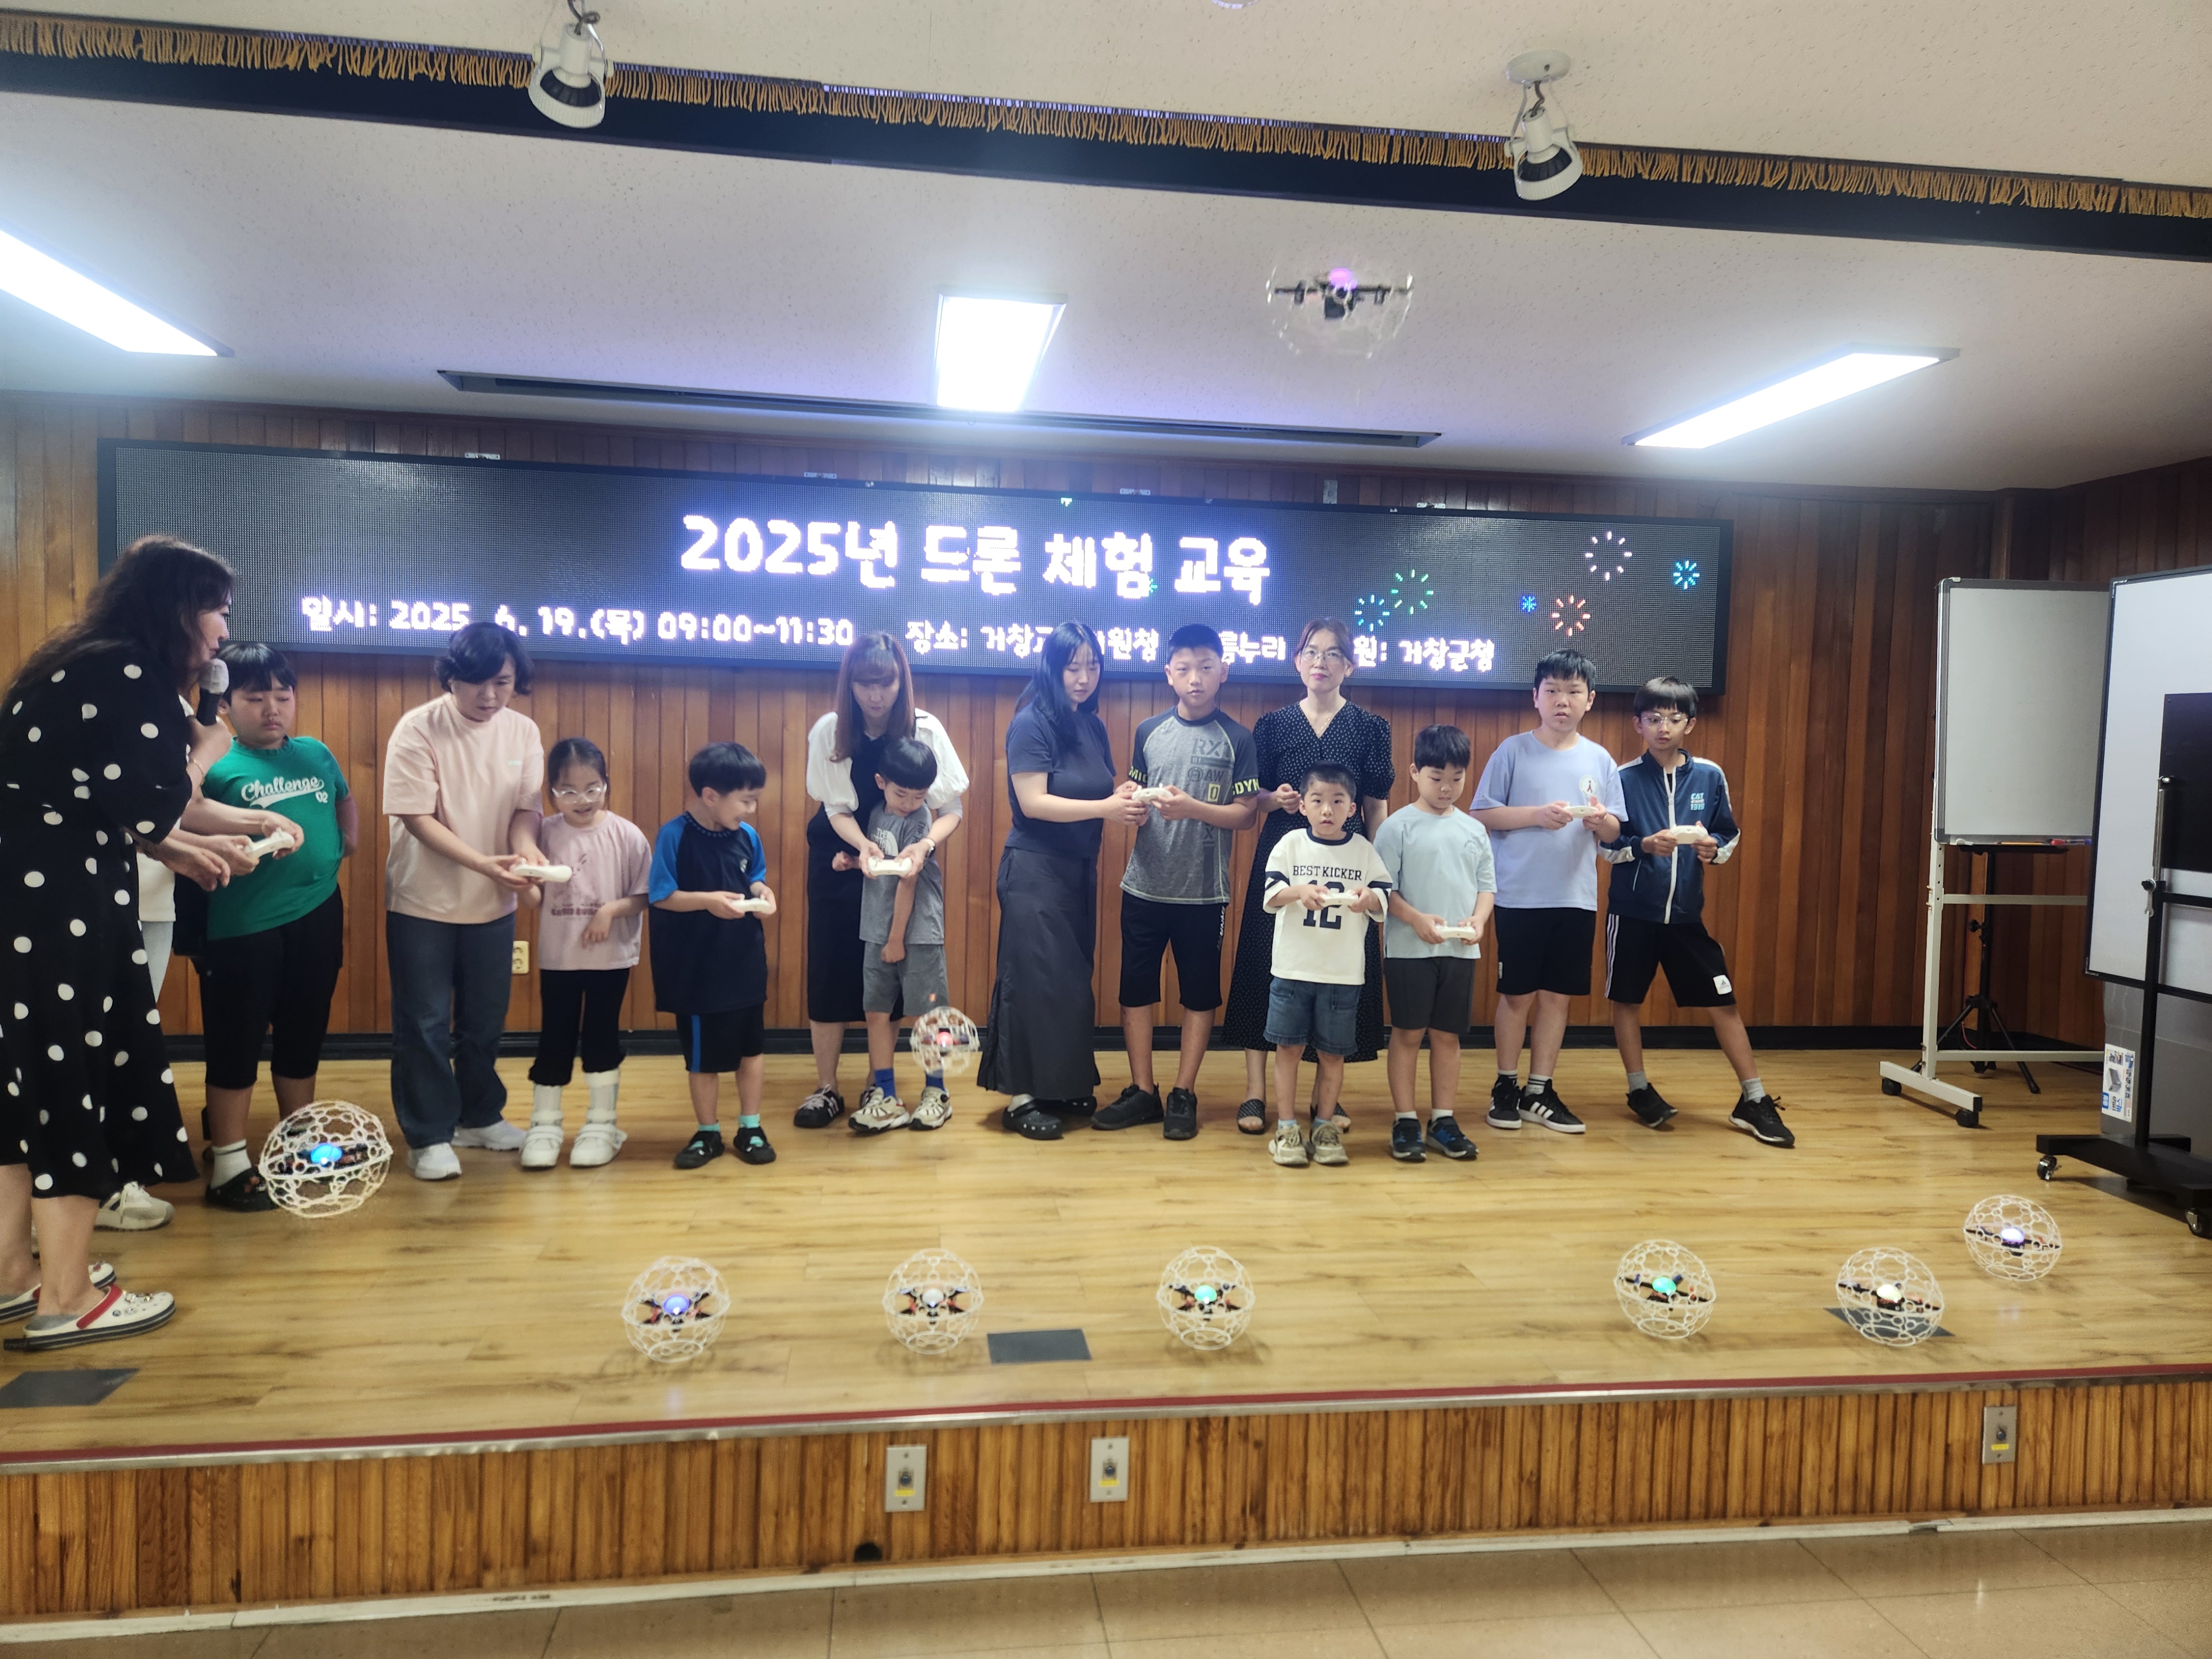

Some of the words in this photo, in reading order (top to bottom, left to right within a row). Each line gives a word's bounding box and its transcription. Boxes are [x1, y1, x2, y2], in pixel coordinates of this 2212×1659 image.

[681, 514, 898, 588] 2025년
[921, 525, 1021, 596] 드론
[1042, 532, 1153, 599] 체험
[1175, 537, 1270, 606] 교육
[301, 594, 378, 632] 일시:
[495, 604, 527, 637] 6.
[658, 611, 853, 646] 09:00~11:30
[905, 619, 967, 655] 장소:
[980, 623, 1159, 662] 거창원청
[1353, 635, 1387, 667] 원:
[1399, 637, 1495, 672] 거창군청
[241, 776, 325, 802] Challenge
[1293, 865, 1321, 876] BEST
[1322, 867, 1362, 881] KICKER
